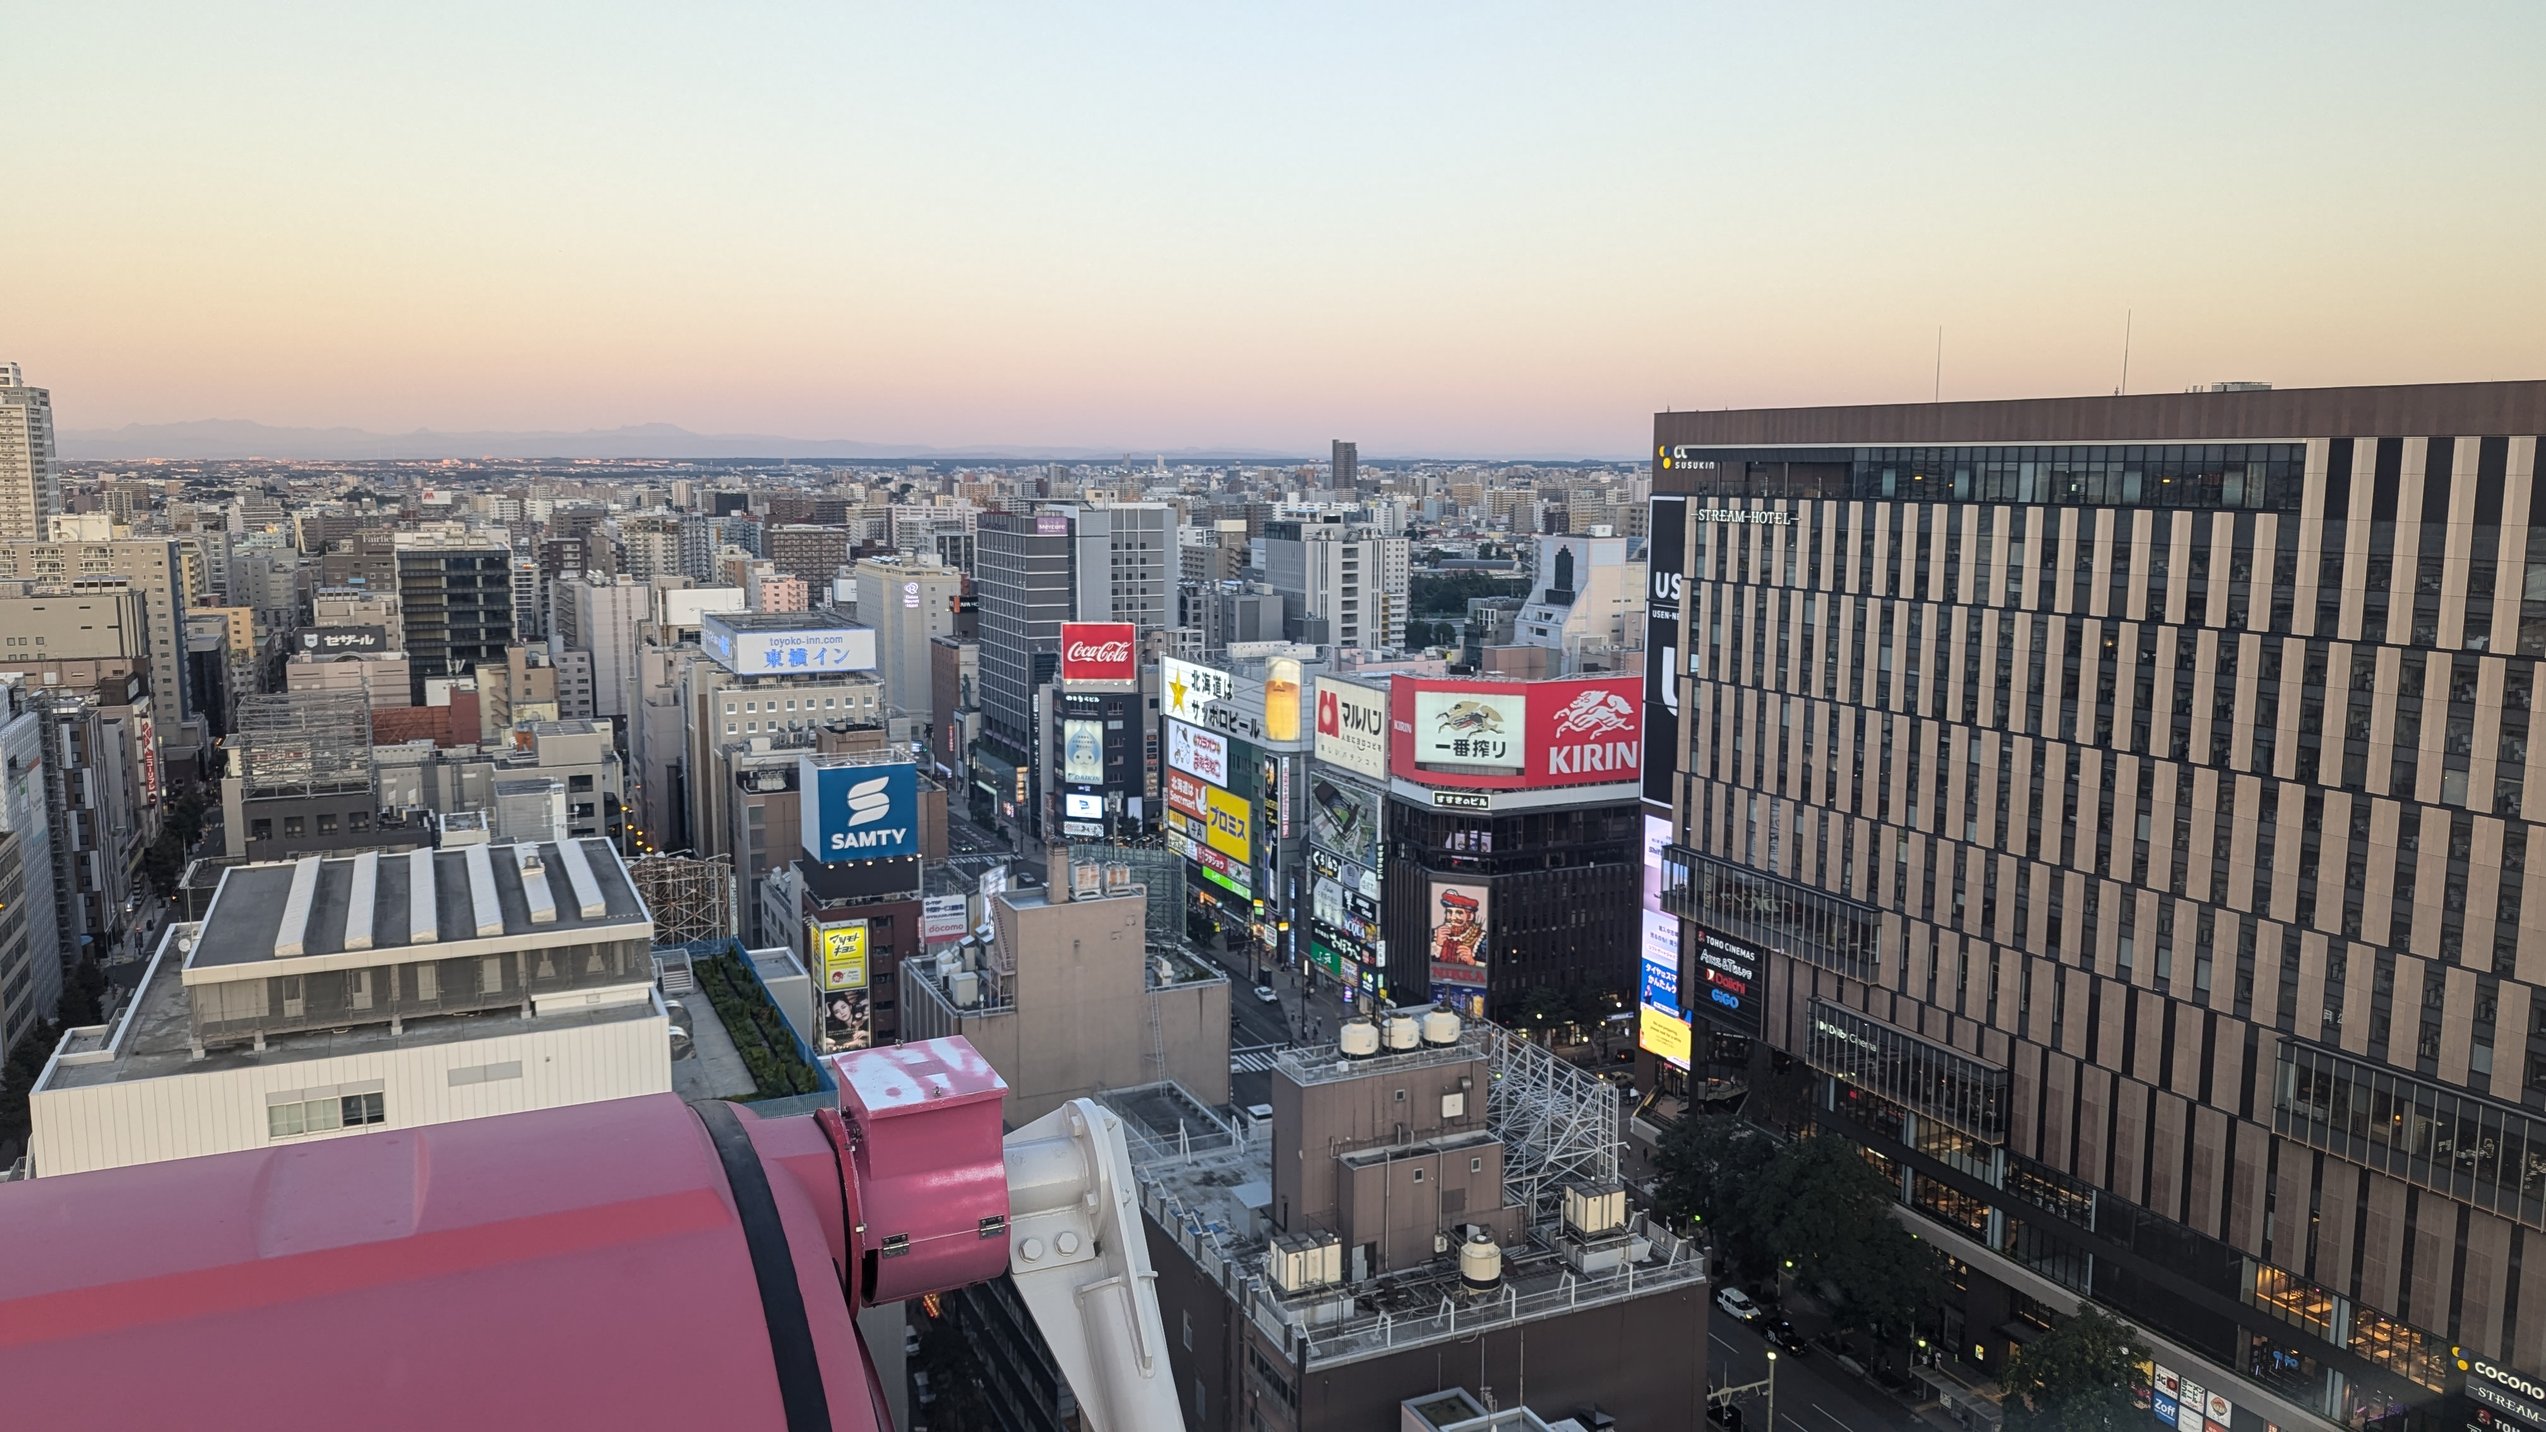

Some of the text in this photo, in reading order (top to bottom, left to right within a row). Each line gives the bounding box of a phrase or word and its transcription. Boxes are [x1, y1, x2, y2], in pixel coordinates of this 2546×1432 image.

[1698, 508, 1791, 525] STREAM HOTEL
[324, 634, 376, 647] セザール
[769, 635, 844, 648] toyoko-inn.com
[764, 648, 851, 669] 東横イン
[1191, 669, 1234, 701] 北海道は
[1191, 699, 1261, 740] サッポロビール
[1341, 701, 1382, 736] マルハン
[1393, 719, 1413, 735] KIRIN
[1435, 738, 1508, 759] 一番搾り
[1548, 741, 1639, 776] KIRIN
[1436, 794, 1488, 807] すすきのビル
[1209, 806, 1247, 842] プロミス
[831, 828, 906, 850] SAMTY
[829, 932, 860, 946] マツモト
[929, 924, 964, 933] docomo
[1706, 935, 1755, 961] TOHO CINEMAS
[1431, 966, 1486, 983] NIKKA
[1711, 988, 1739, 1009] GiGO
[2475, 1361, 2546, 1400] cocono
[2155, 1398, 2177, 1418] Zoff
[2478, 1387, 2540, 1422] STREAM
